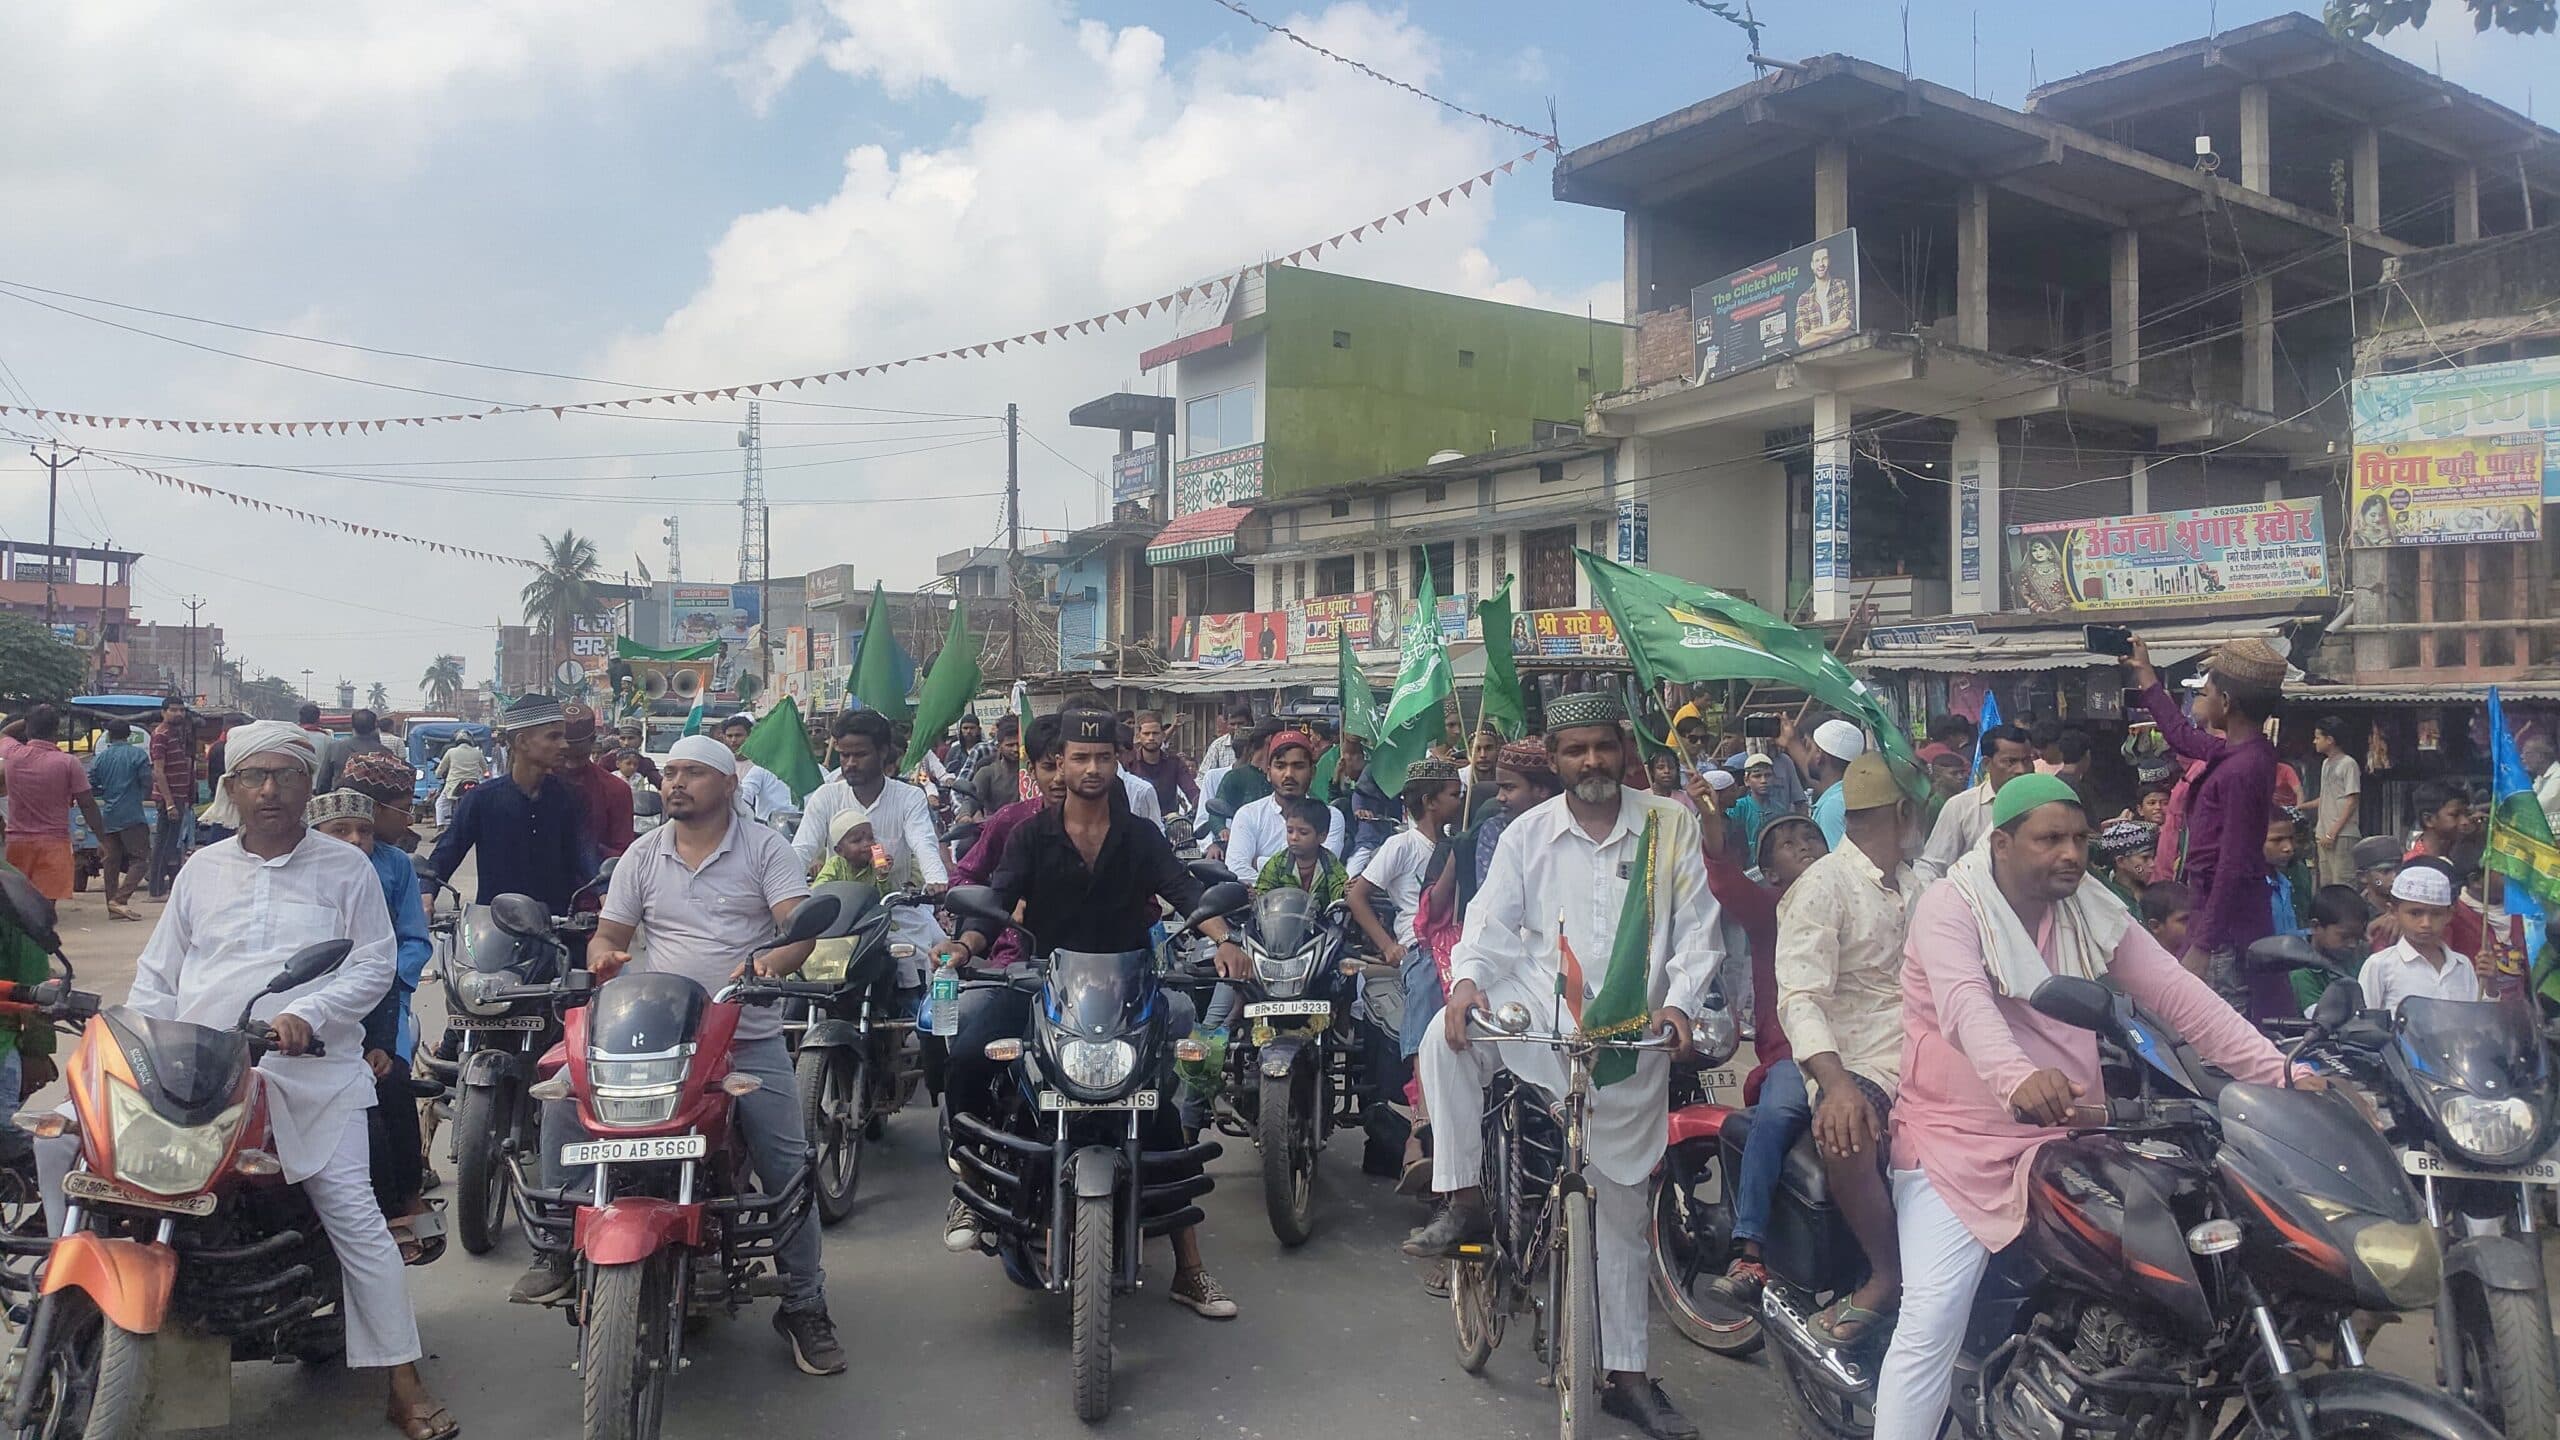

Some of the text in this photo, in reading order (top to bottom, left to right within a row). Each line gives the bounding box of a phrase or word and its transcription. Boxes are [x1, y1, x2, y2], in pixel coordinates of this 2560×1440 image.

[1711, 292, 1732, 307] The
[1733, 278, 1767, 297] Clicks
[1768, 266, 1799, 284] Ninja
[1716, 300, 1737, 315] Digital
[1738, 290, 1771, 305] Marketing
[1771, 281, 1796, 295] Agency
[2084, 519, 2169, 560] अंजना
[2253, 502, 2315, 546] स्टोर
[1306, 600, 1325, 618] राजा
[1538, 613, 1559, 635] श्री
[1564, 612, 1592, 635] राधे
[580, 1140, 697, 1162] BR50 AB 5660
